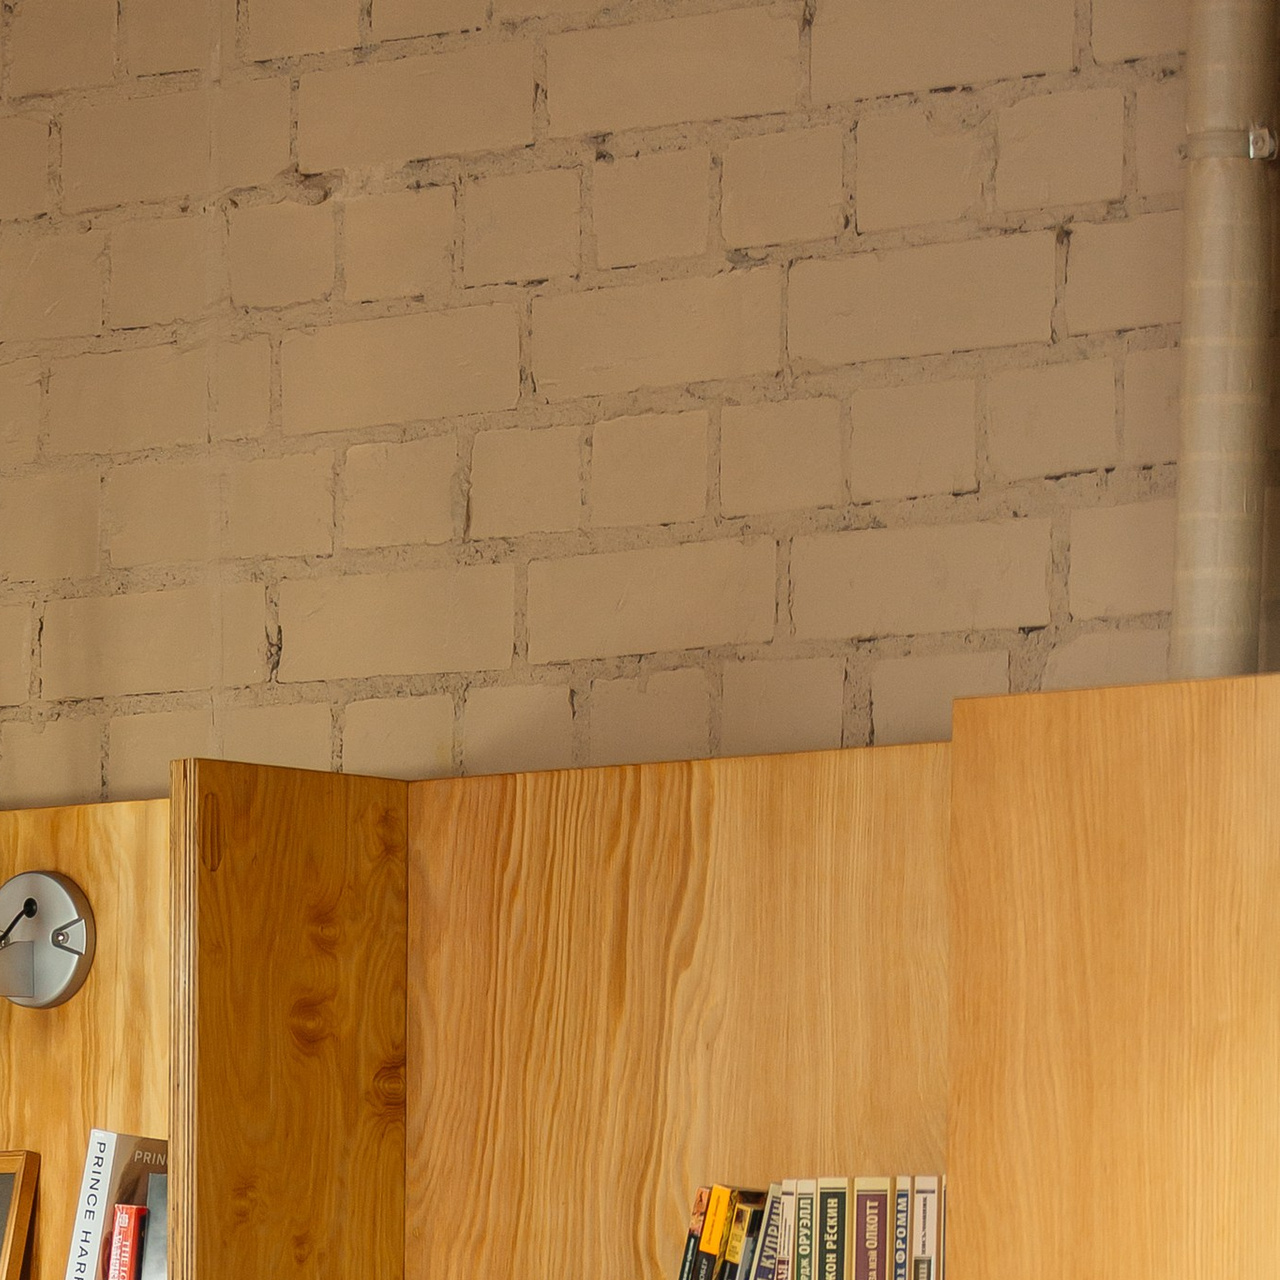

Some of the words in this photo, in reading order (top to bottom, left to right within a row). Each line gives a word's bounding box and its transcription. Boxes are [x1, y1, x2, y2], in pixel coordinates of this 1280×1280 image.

[84, 1142, 106, 1221] PRINCE
[798, 1198, 811, 1254] ОРУЭЛЛ
[823, 1198, 838, 1249] РЁСКИН
[896, 1198, 907, 1264] ФРОММ
